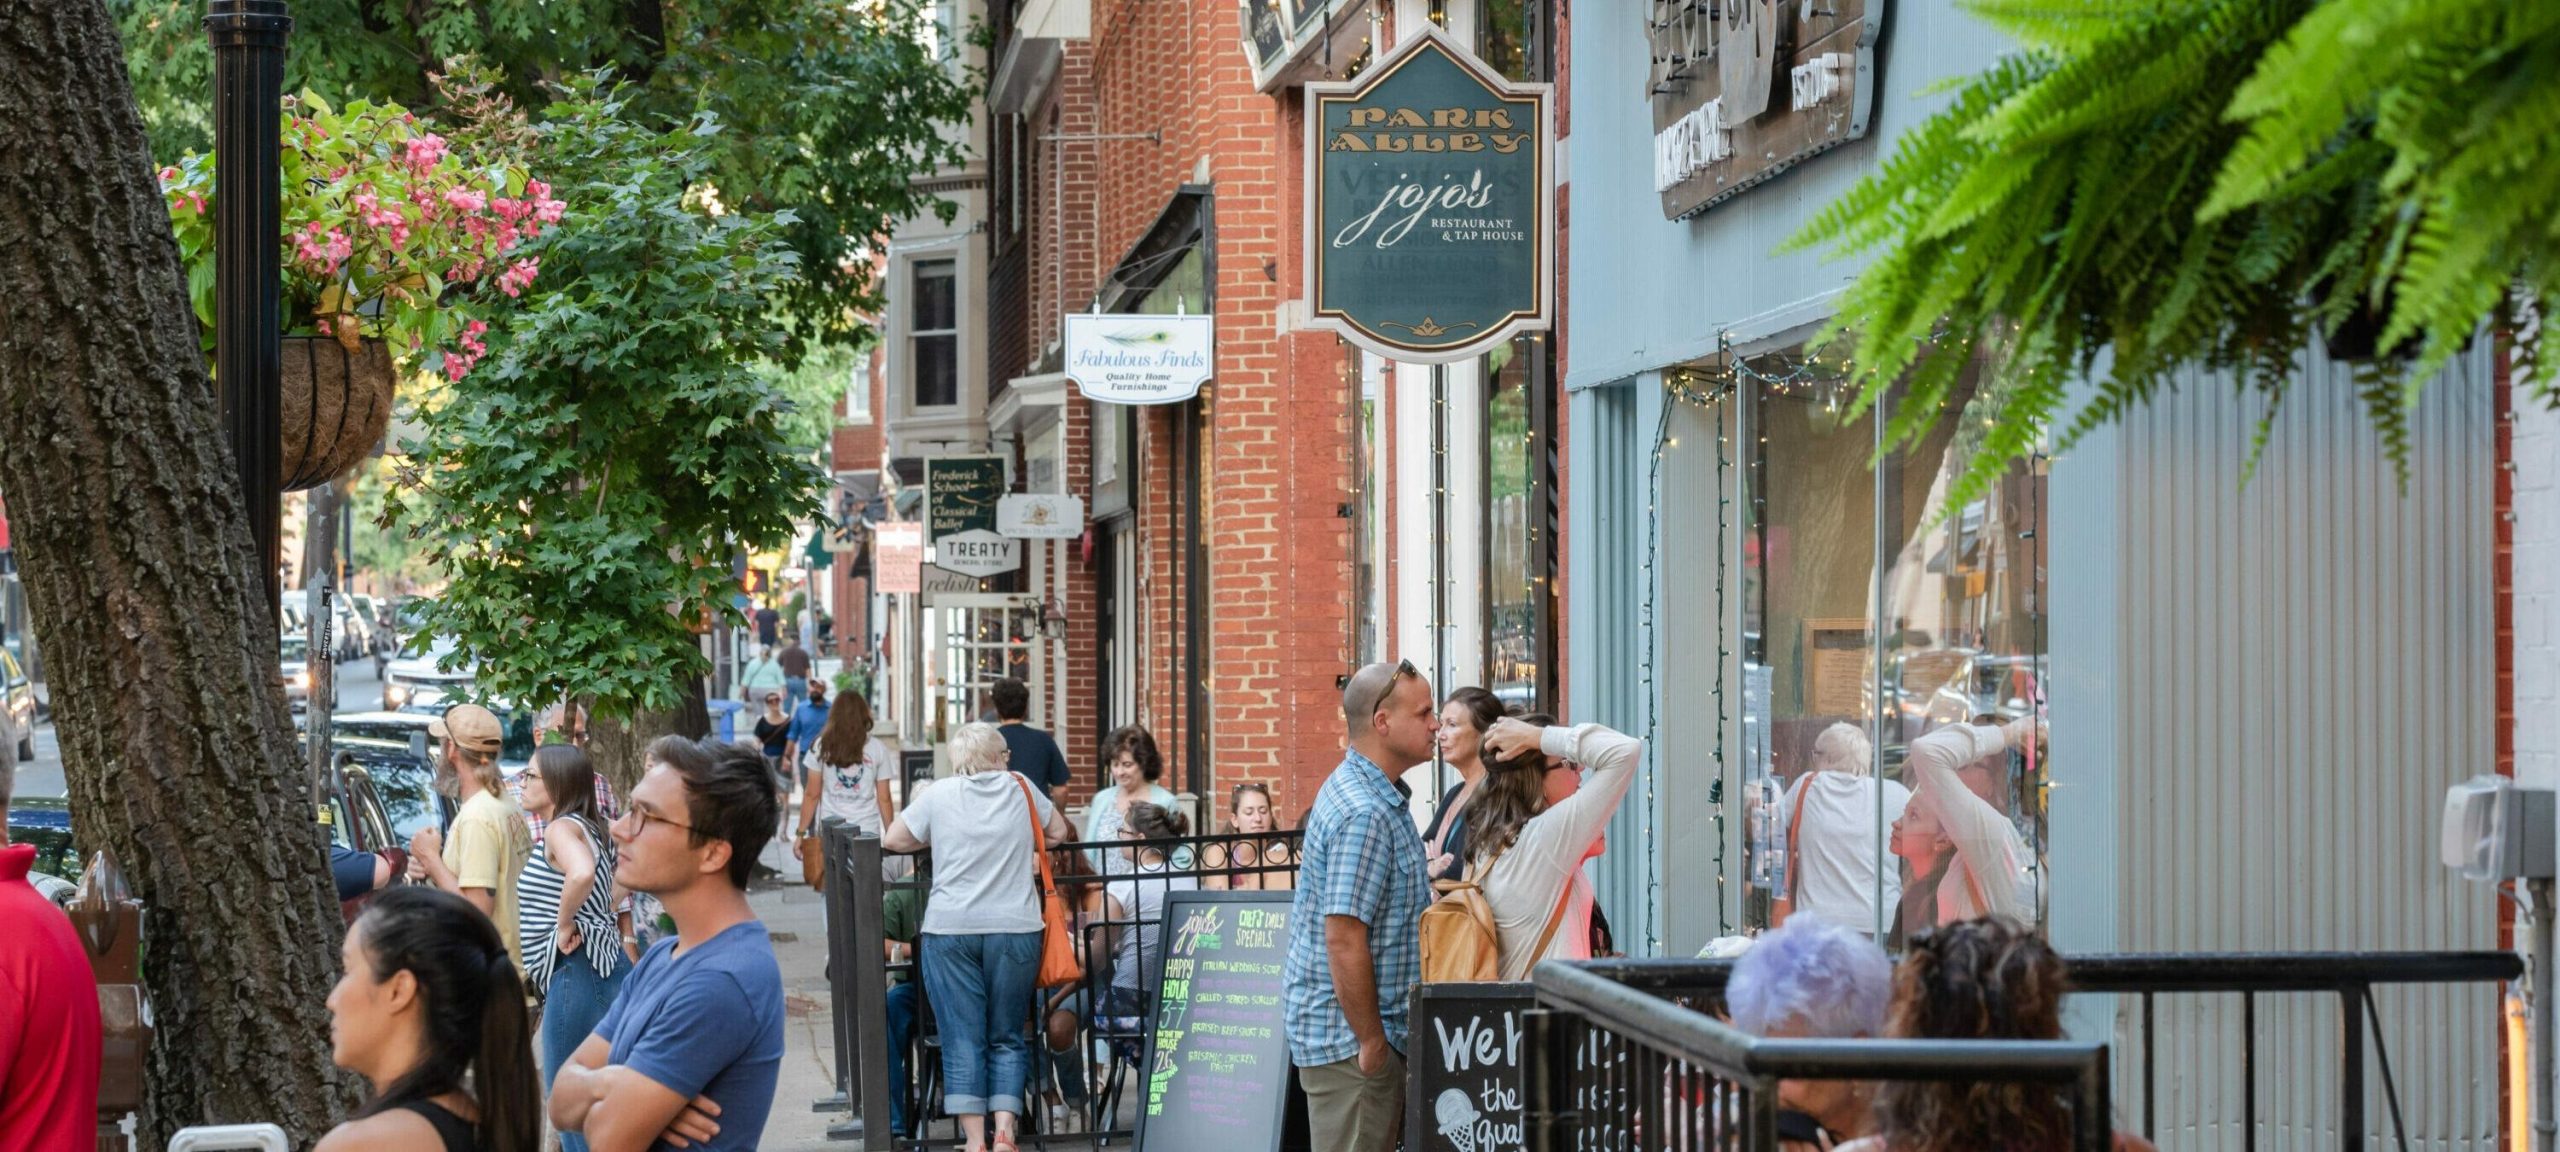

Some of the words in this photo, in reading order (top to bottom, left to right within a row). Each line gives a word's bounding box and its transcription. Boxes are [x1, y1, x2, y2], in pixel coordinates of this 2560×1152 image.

[1346, 107, 1514, 129] PARK
[1326, 132, 1532, 153] ALLEY
[1333, 168, 1493, 249] jojo's
[1431, 219, 1513, 229] RESTAURANT
[1442, 231, 1453, 242] &
[1455, 231, 1479, 241] TAP
[1482, 231, 1524, 241] HOUSE
[1073, 348, 1151, 367] Fabulous
[1155, 348, 1204, 367] Finds
[1106, 373, 1141, 381] Quality
[1145, 373, 1172, 381] Home
[1111, 383, 1168, 391] Furnishings
[932, 469, 979, 481] Frederick
[932, 481, 970, 492] School
[932, 493, 946, 504] of
[932, 505, 978, 517] Classical
[934, 518, 964, 529] Ballet
[947, 541, 1010, 557] TREATY
[926, 572, 976, 592] relish
[1165, 958, 1194, 980] HAPPY
[1163, 979, 1189, 1000] HOUR
[1159, 1000, 1187, 1029] 3-7
[1480, 1077, 1523, 1112] the
